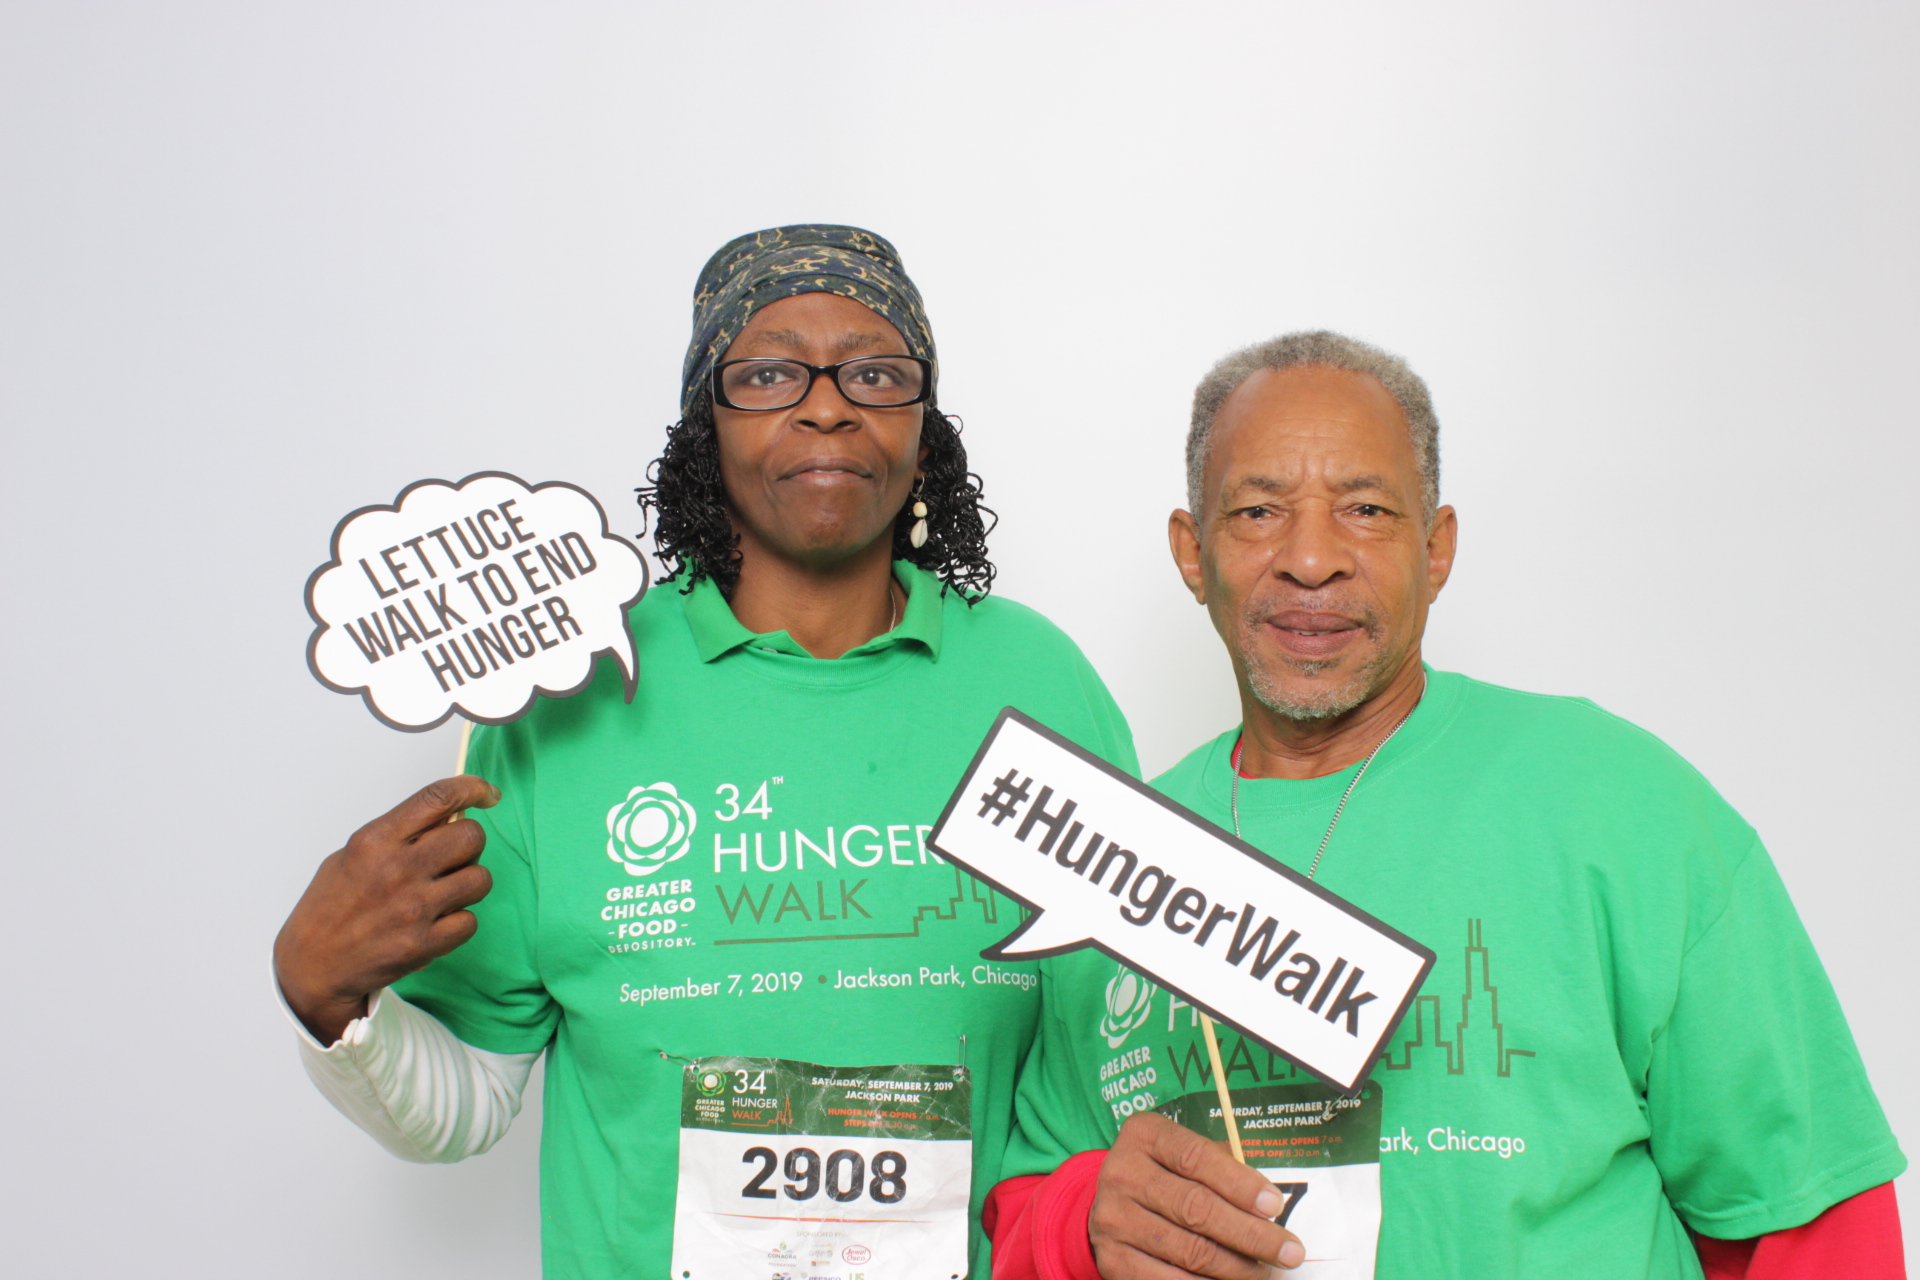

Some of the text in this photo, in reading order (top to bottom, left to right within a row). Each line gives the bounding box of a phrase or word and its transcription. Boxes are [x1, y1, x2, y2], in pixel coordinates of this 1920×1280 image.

[358, 498, 536, 600] LETTUCE
[343, 532, 597, 664] WALK TO END
[421, 596, 583, 693] HUNGER
[714, 824, 945, 873] HUNGER
[606, 879, 692, 902] GREATER
[715, 879, 873, 925] WALK
[601, 897, 696, 921] CHICAGO
[976, 768, 1379, 1037] #HungerWalk
[620, 964, 1037, 1006] September 7, 2019 Jackson Park, Chicago
[1100, 1046, 1152, 1081] GREATER
[1167, 1035, 1297, 1092] WAL
[811, 1076, 954, 1092] SATURDAY, SEPTEMBER 7, 2019
[1101, 1067, 1157, 1103] CHICAGO
[732, 1097, 777, 1109] HUNGER
[845, 1090, 921, 1103] JACKSON PARK
[1209, 1105, 1264, 1118] SARDAY,
[1267, 1101, 1323, 1115] SEPTEMBER
[1335, 1098, 1361, 1109] 2019
[694, 1104, 726, 1113] CHICAGO
[732, 1109, 762, 1120] WALK
[828, 1108, 863, 1117] HUNGER
[864, 1110, 888, 1118] WALK
[889, 1111, 917, 1120] OPENS
[843, 1119, 867, 1127] STEPS
[1243, 1115, 1322, 1129] JACKSON PARK
[1263, 1138, 1289, 1147] WALK
[1290, 1136, 1320, 1145] OPENS
[1321, 1135, 1328, 1144] 7
[1380, 1126, 1525, 1159] ark, Chicago
[1243, 1150, 1266, 1158] STEPS
[1267, 1149, 1284, 1157] OFF
[742, 1146, 907, 1204] 2908
[767, 1252, 797, 1260] CONAGRA
[846, 1248, 867, 1256] Jewel
